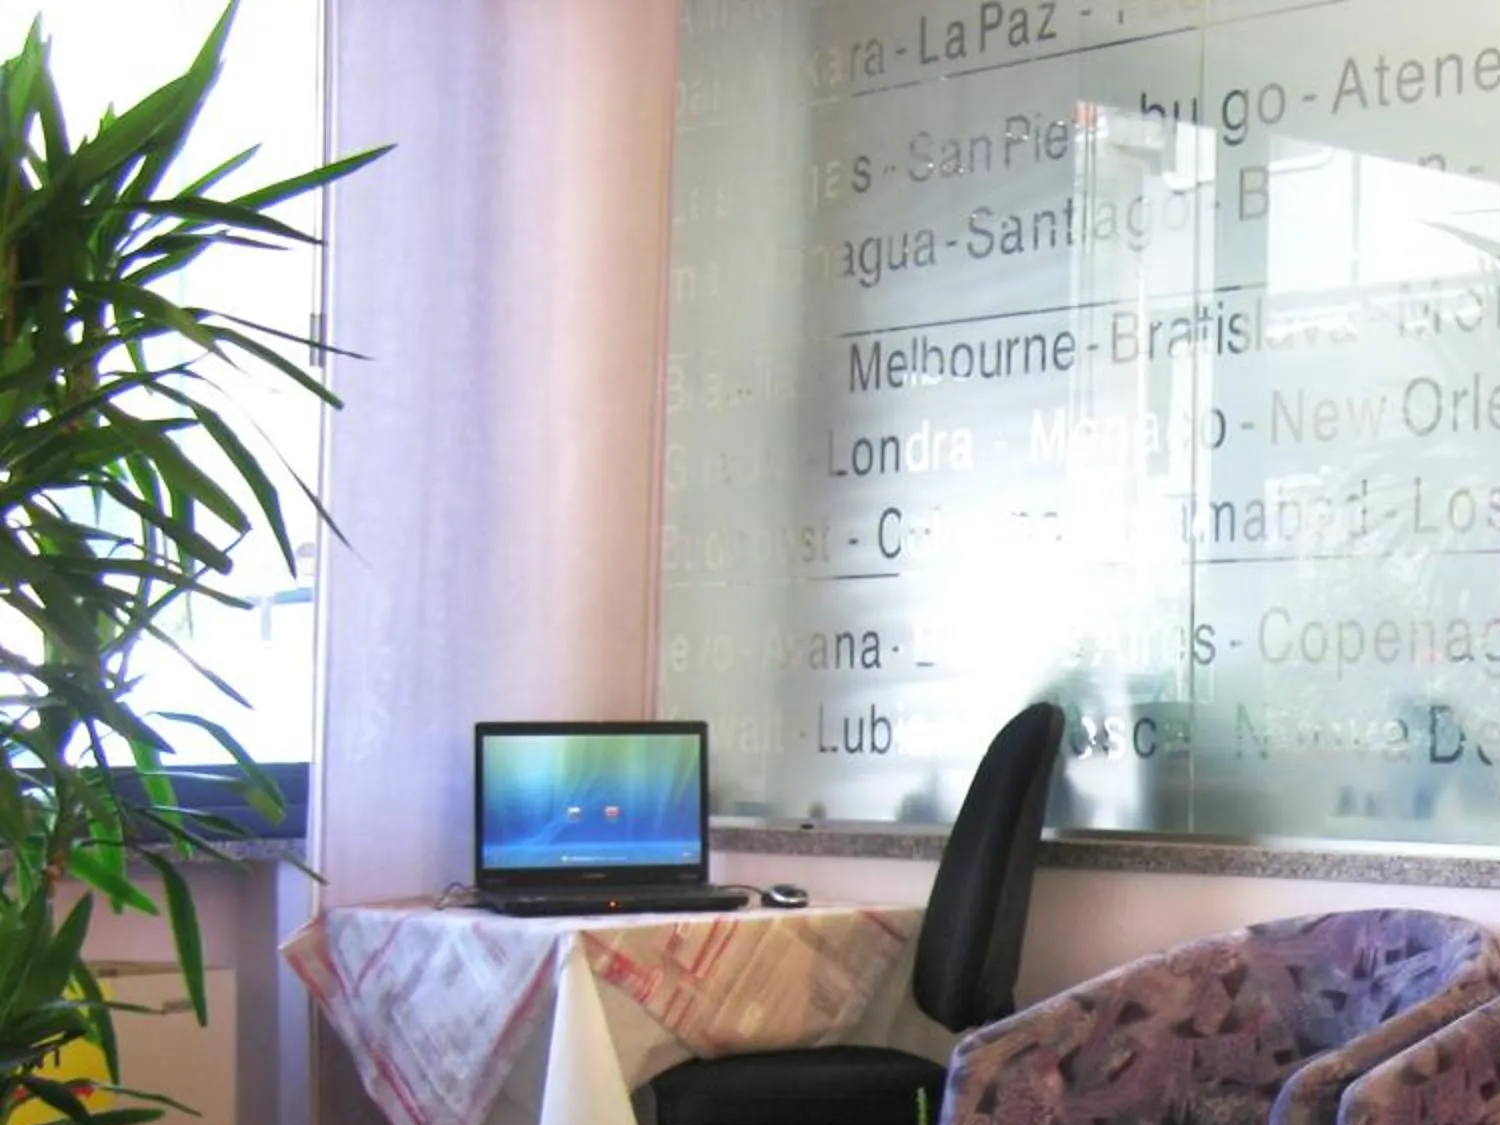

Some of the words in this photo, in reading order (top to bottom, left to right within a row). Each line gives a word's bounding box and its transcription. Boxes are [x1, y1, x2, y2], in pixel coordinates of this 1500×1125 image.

[919, 15, 967, 66] La
[979, 0, 1058, 53] Paz
[908, 130, 994, 183] San
[847, 329, 1077, 394] Melbourne
[1110, 297, 1358, 365] Bratisl
[827, 418, 975, 479] Londra
[1029, 405, 1227, 462] Monao
[1270, 386, 1389, 446] New
